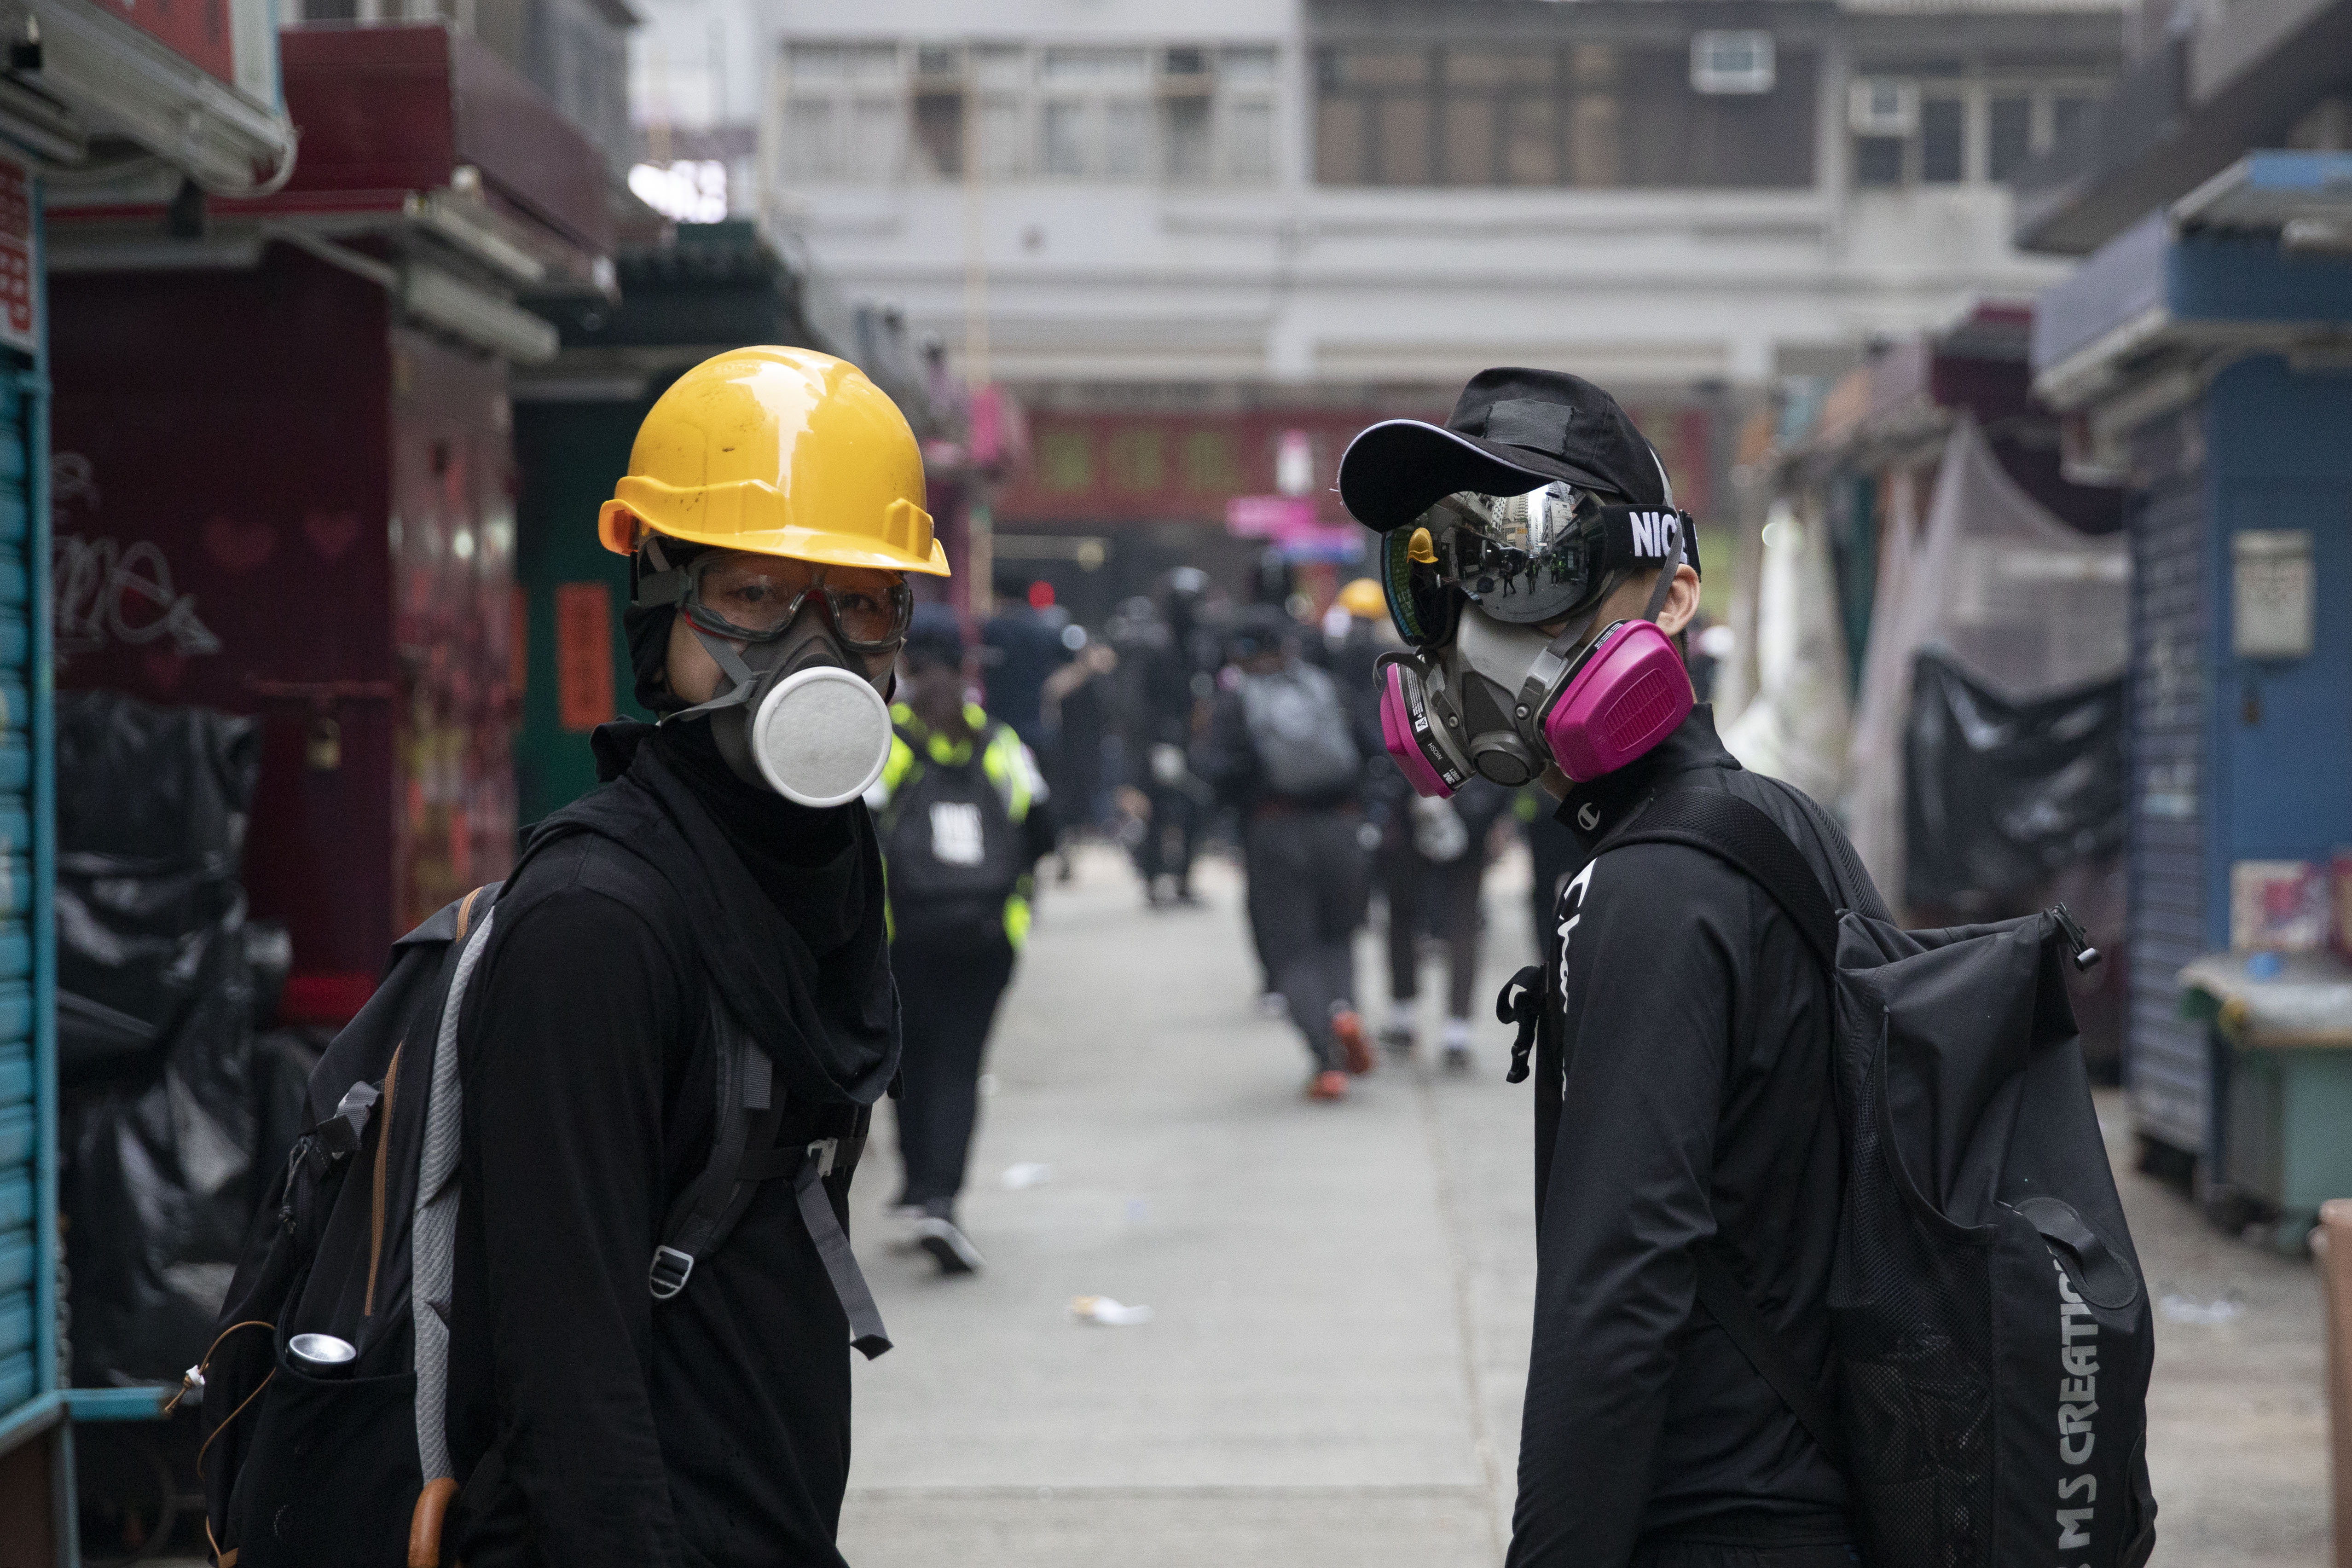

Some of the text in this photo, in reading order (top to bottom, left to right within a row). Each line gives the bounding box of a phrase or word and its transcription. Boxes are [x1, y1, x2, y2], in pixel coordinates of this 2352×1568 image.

[1629, 512, 1687, 563] NIC
[1428, 743, 1442, 760] NIOSH
[1443, 772, 1454, 784] 3M
[2048, 1245, 2100, 1465] CREATI
